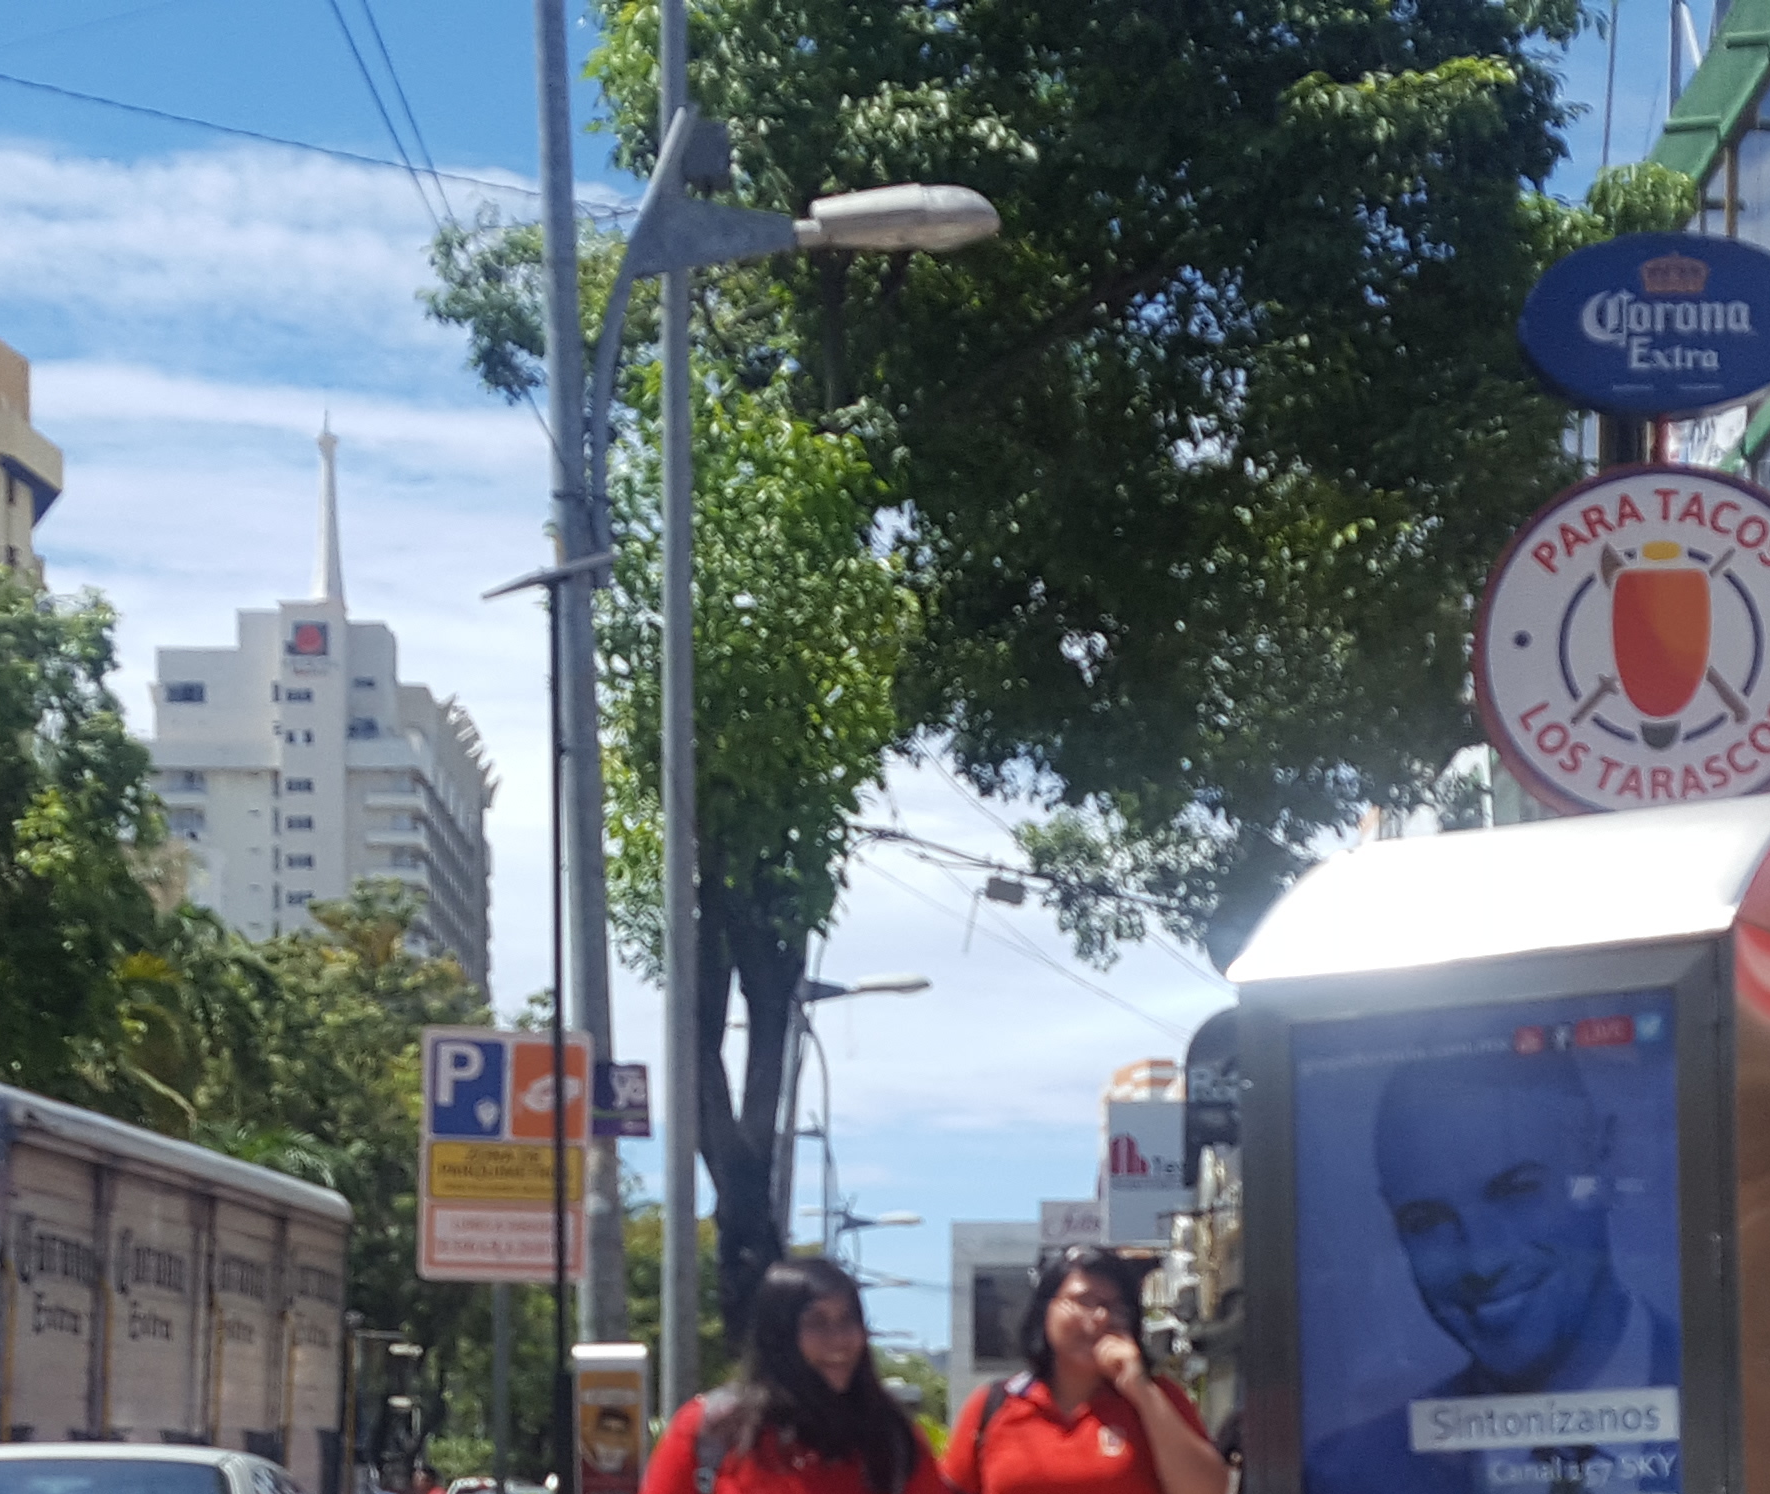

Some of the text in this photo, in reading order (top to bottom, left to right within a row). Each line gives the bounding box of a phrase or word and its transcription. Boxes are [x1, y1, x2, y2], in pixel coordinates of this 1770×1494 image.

[1581, 289, 1754, 346] Corona
[1629, 336, 1720, 371] Extra
[1531, 493, 1645, 573] PARA
[1519, 701, 1591, 773] LOS
[436, 1042, 483, 1106] P
[1488, 1456, 1562, 1484] Canal
[1619, 1453, 1677, 1479] SKY
